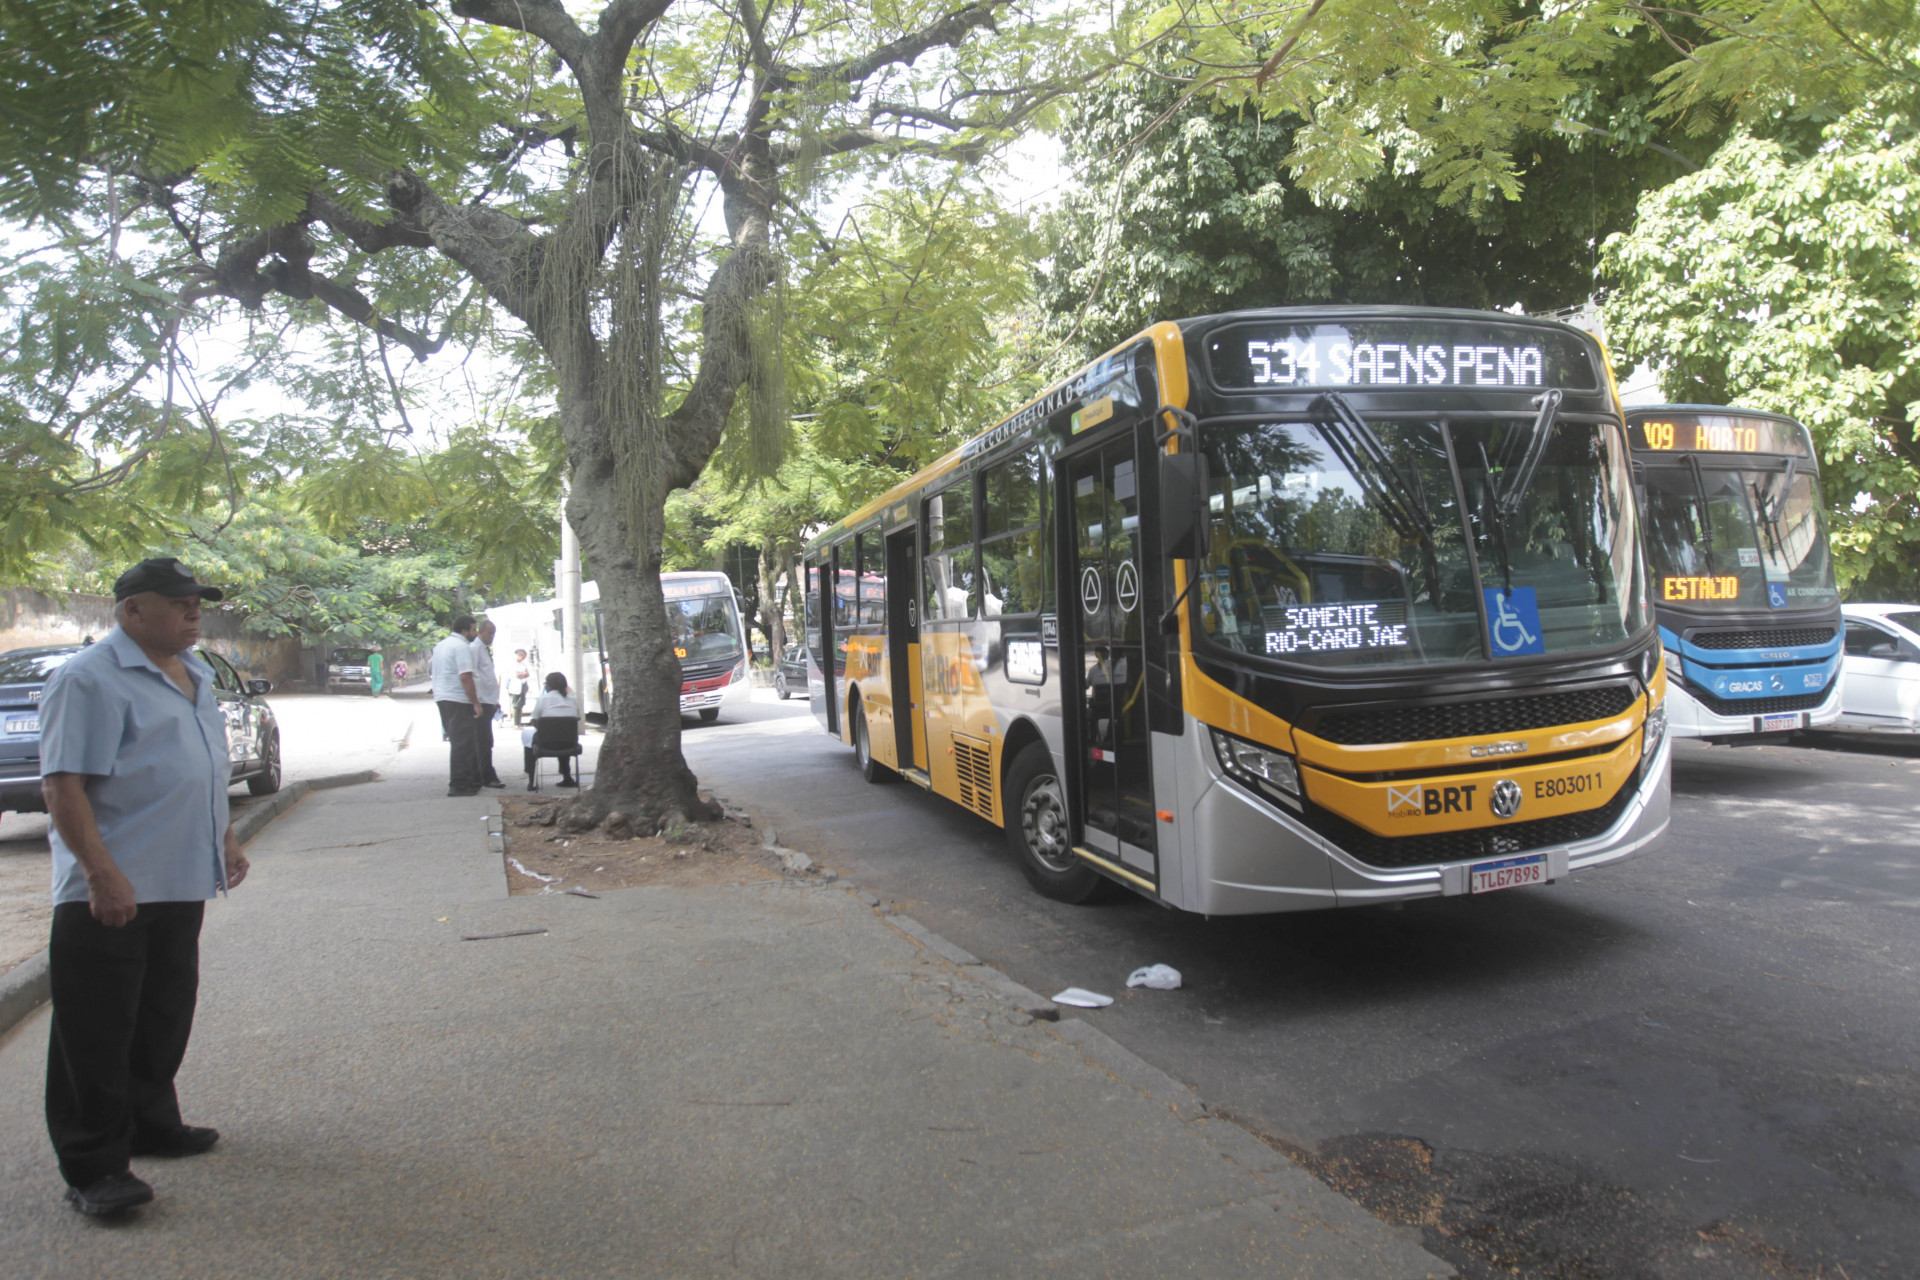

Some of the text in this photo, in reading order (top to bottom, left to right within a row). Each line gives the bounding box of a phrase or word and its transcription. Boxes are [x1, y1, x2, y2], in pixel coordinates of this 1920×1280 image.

[1248, 341, 1542, 385] 534 SAENS PENA
[988, 377, 1084, 447] CONDICIONADO
[1696, 425, 1757, 452] HORTO
[1664, 576, 1738, 600] ESTACIO
[1285, 604, 1379, 629] SOMENTE
[1265, 624, 1407, 653] RIO-CARD JAE
[1729, 681, 1763, 693] GRAÇAS
[1535, 772, 1602, 798] E803011
[1424, 785, 1477, 815] BRT
[1480, 865, 1540, 889] TLG7B98
